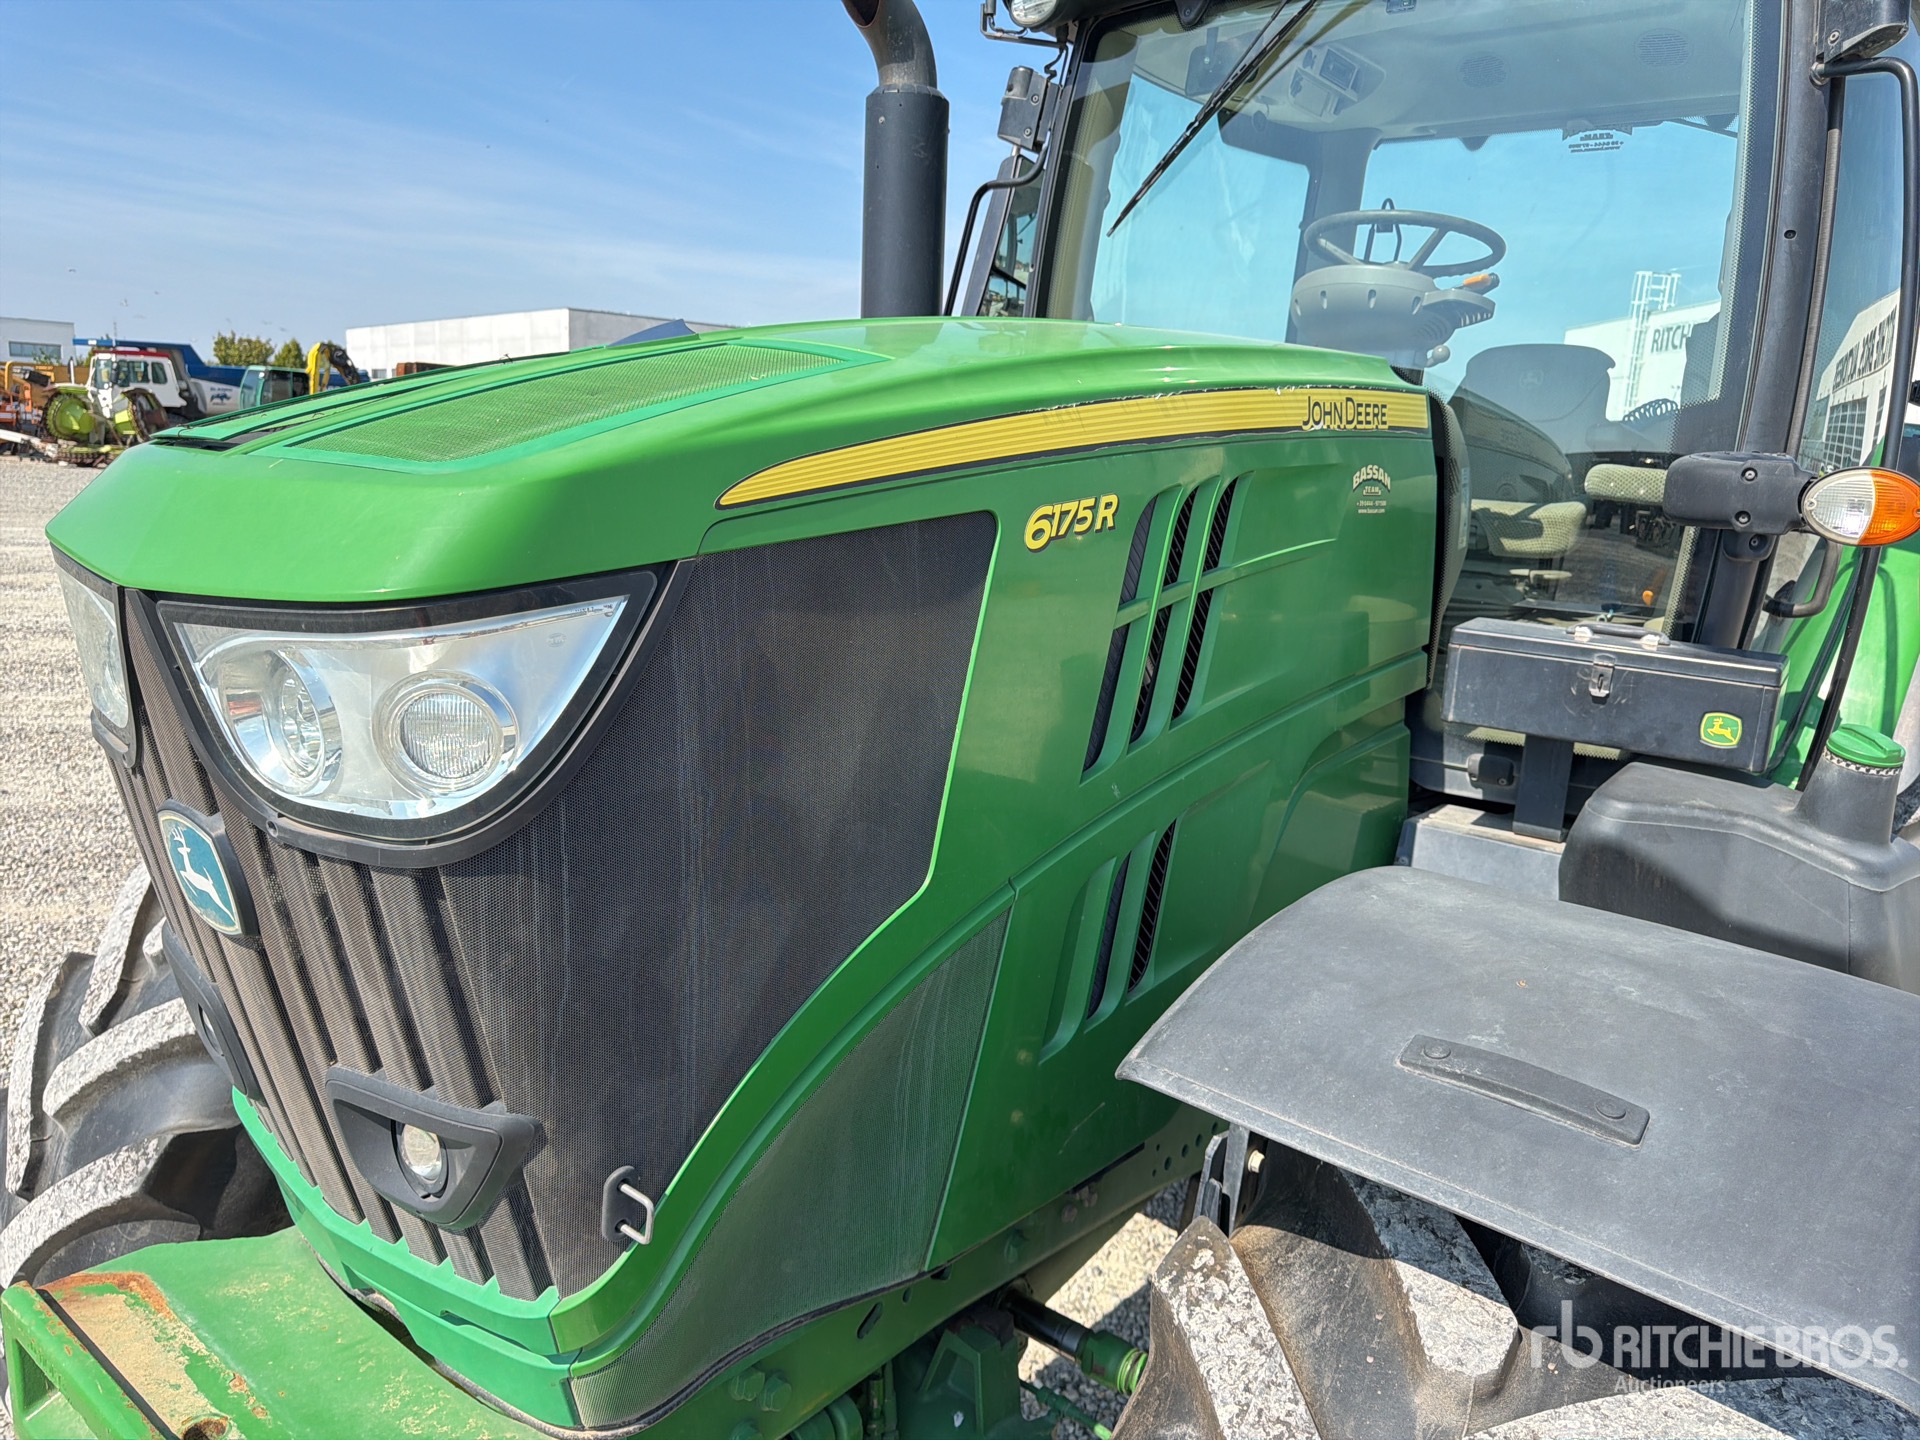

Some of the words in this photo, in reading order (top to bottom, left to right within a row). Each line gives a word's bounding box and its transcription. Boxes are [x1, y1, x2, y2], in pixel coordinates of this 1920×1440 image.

[1302, 395, 1343, 427] JOHN
[1345, 397, 1388, 427] DEERE
[1352, 464, 1391, 491] BASSAN
[1024, 493, 1119, 553] 6175R
